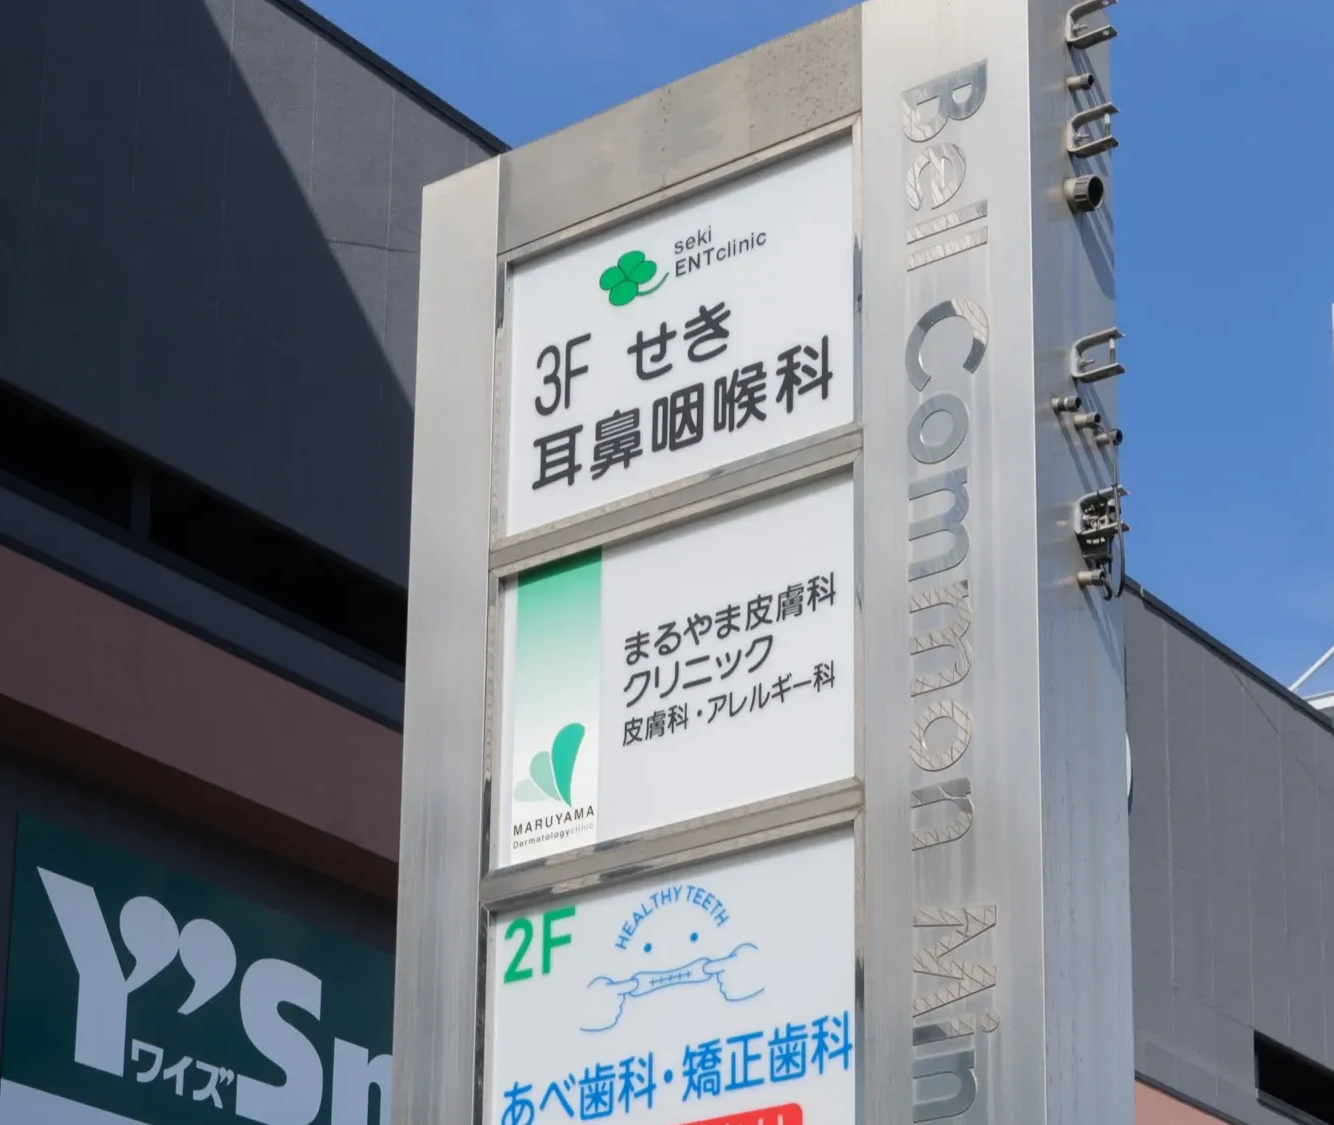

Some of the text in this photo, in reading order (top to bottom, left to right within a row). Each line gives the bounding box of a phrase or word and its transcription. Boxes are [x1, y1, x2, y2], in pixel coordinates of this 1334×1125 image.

[901, 58, 989, 273] Bell
[673, 226, 713, 255] seki
[534, 332, 592, 417] 3F
[627, 300, 732, 381] せき
[531, 335, 834, 491] 耳鼻咽喉科
[905, 297, 990, 853] Common
[623, 571, 837, 667] まるやま皮膚科
[622, 660, 837, 747] 皮膚科・アレルギー科
[623, 634, 774, 708] クリニック
[513, 805, 595, 837] MARUYAMA
[503, 905, 577, 984] 2F
[615, 884, 730, 951] HEALTHY TEETH
[130, 1038, 235, 1109] ワイズ
